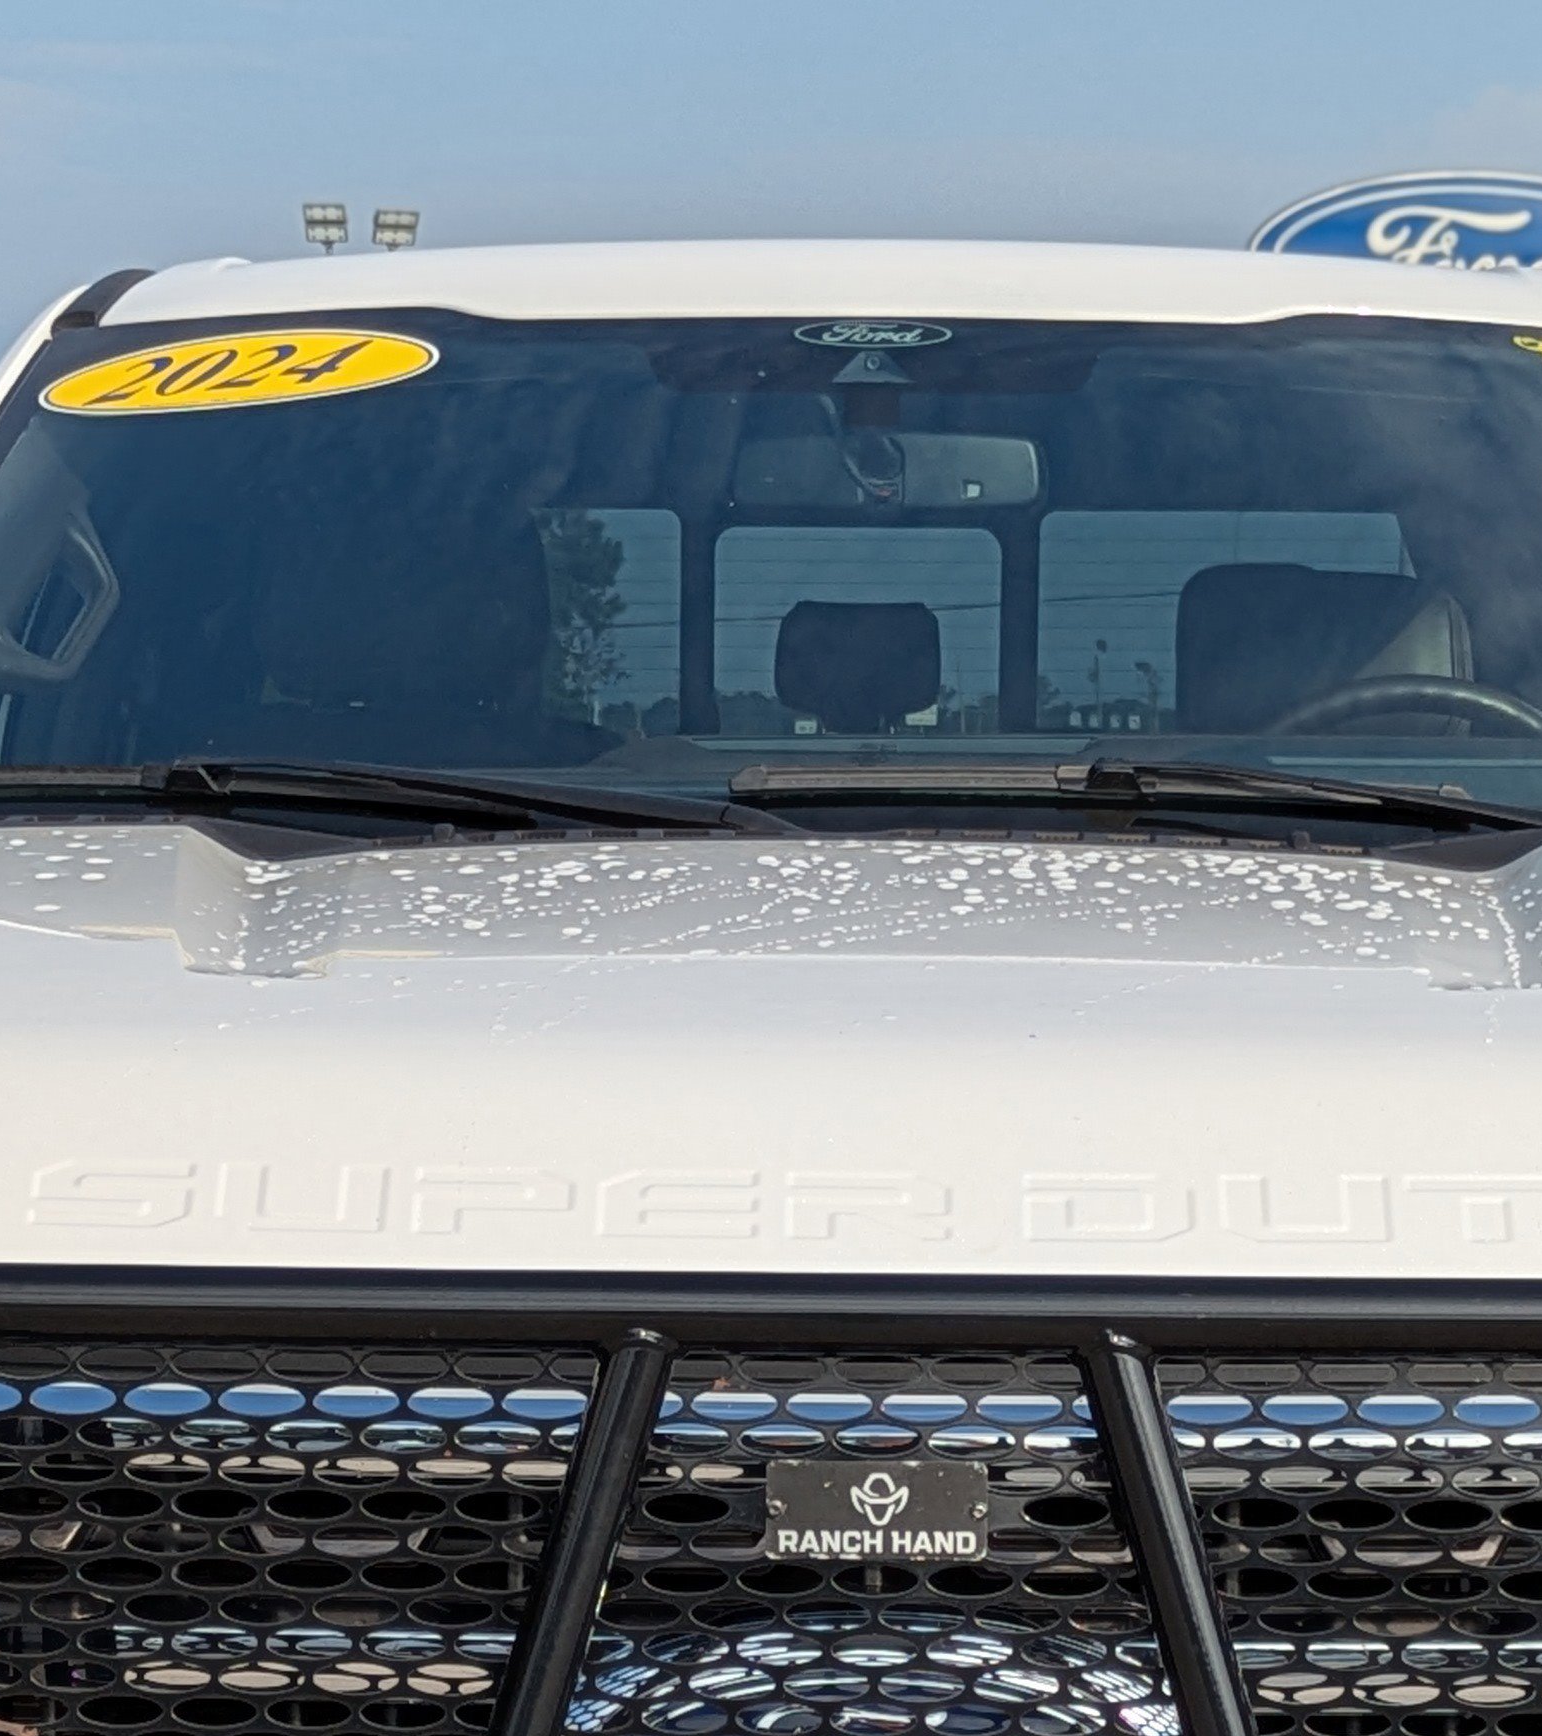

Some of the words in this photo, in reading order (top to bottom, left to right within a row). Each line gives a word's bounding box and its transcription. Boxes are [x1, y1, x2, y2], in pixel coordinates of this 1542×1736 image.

[822, 323, 924, 343] Ford
[82, 339, 374, 407] 2024
[27, 1160, 952, 1242] SUPER
[777, 1529, 884, 1554] RANCH
[891, 1530, 977, 1554] HAND
